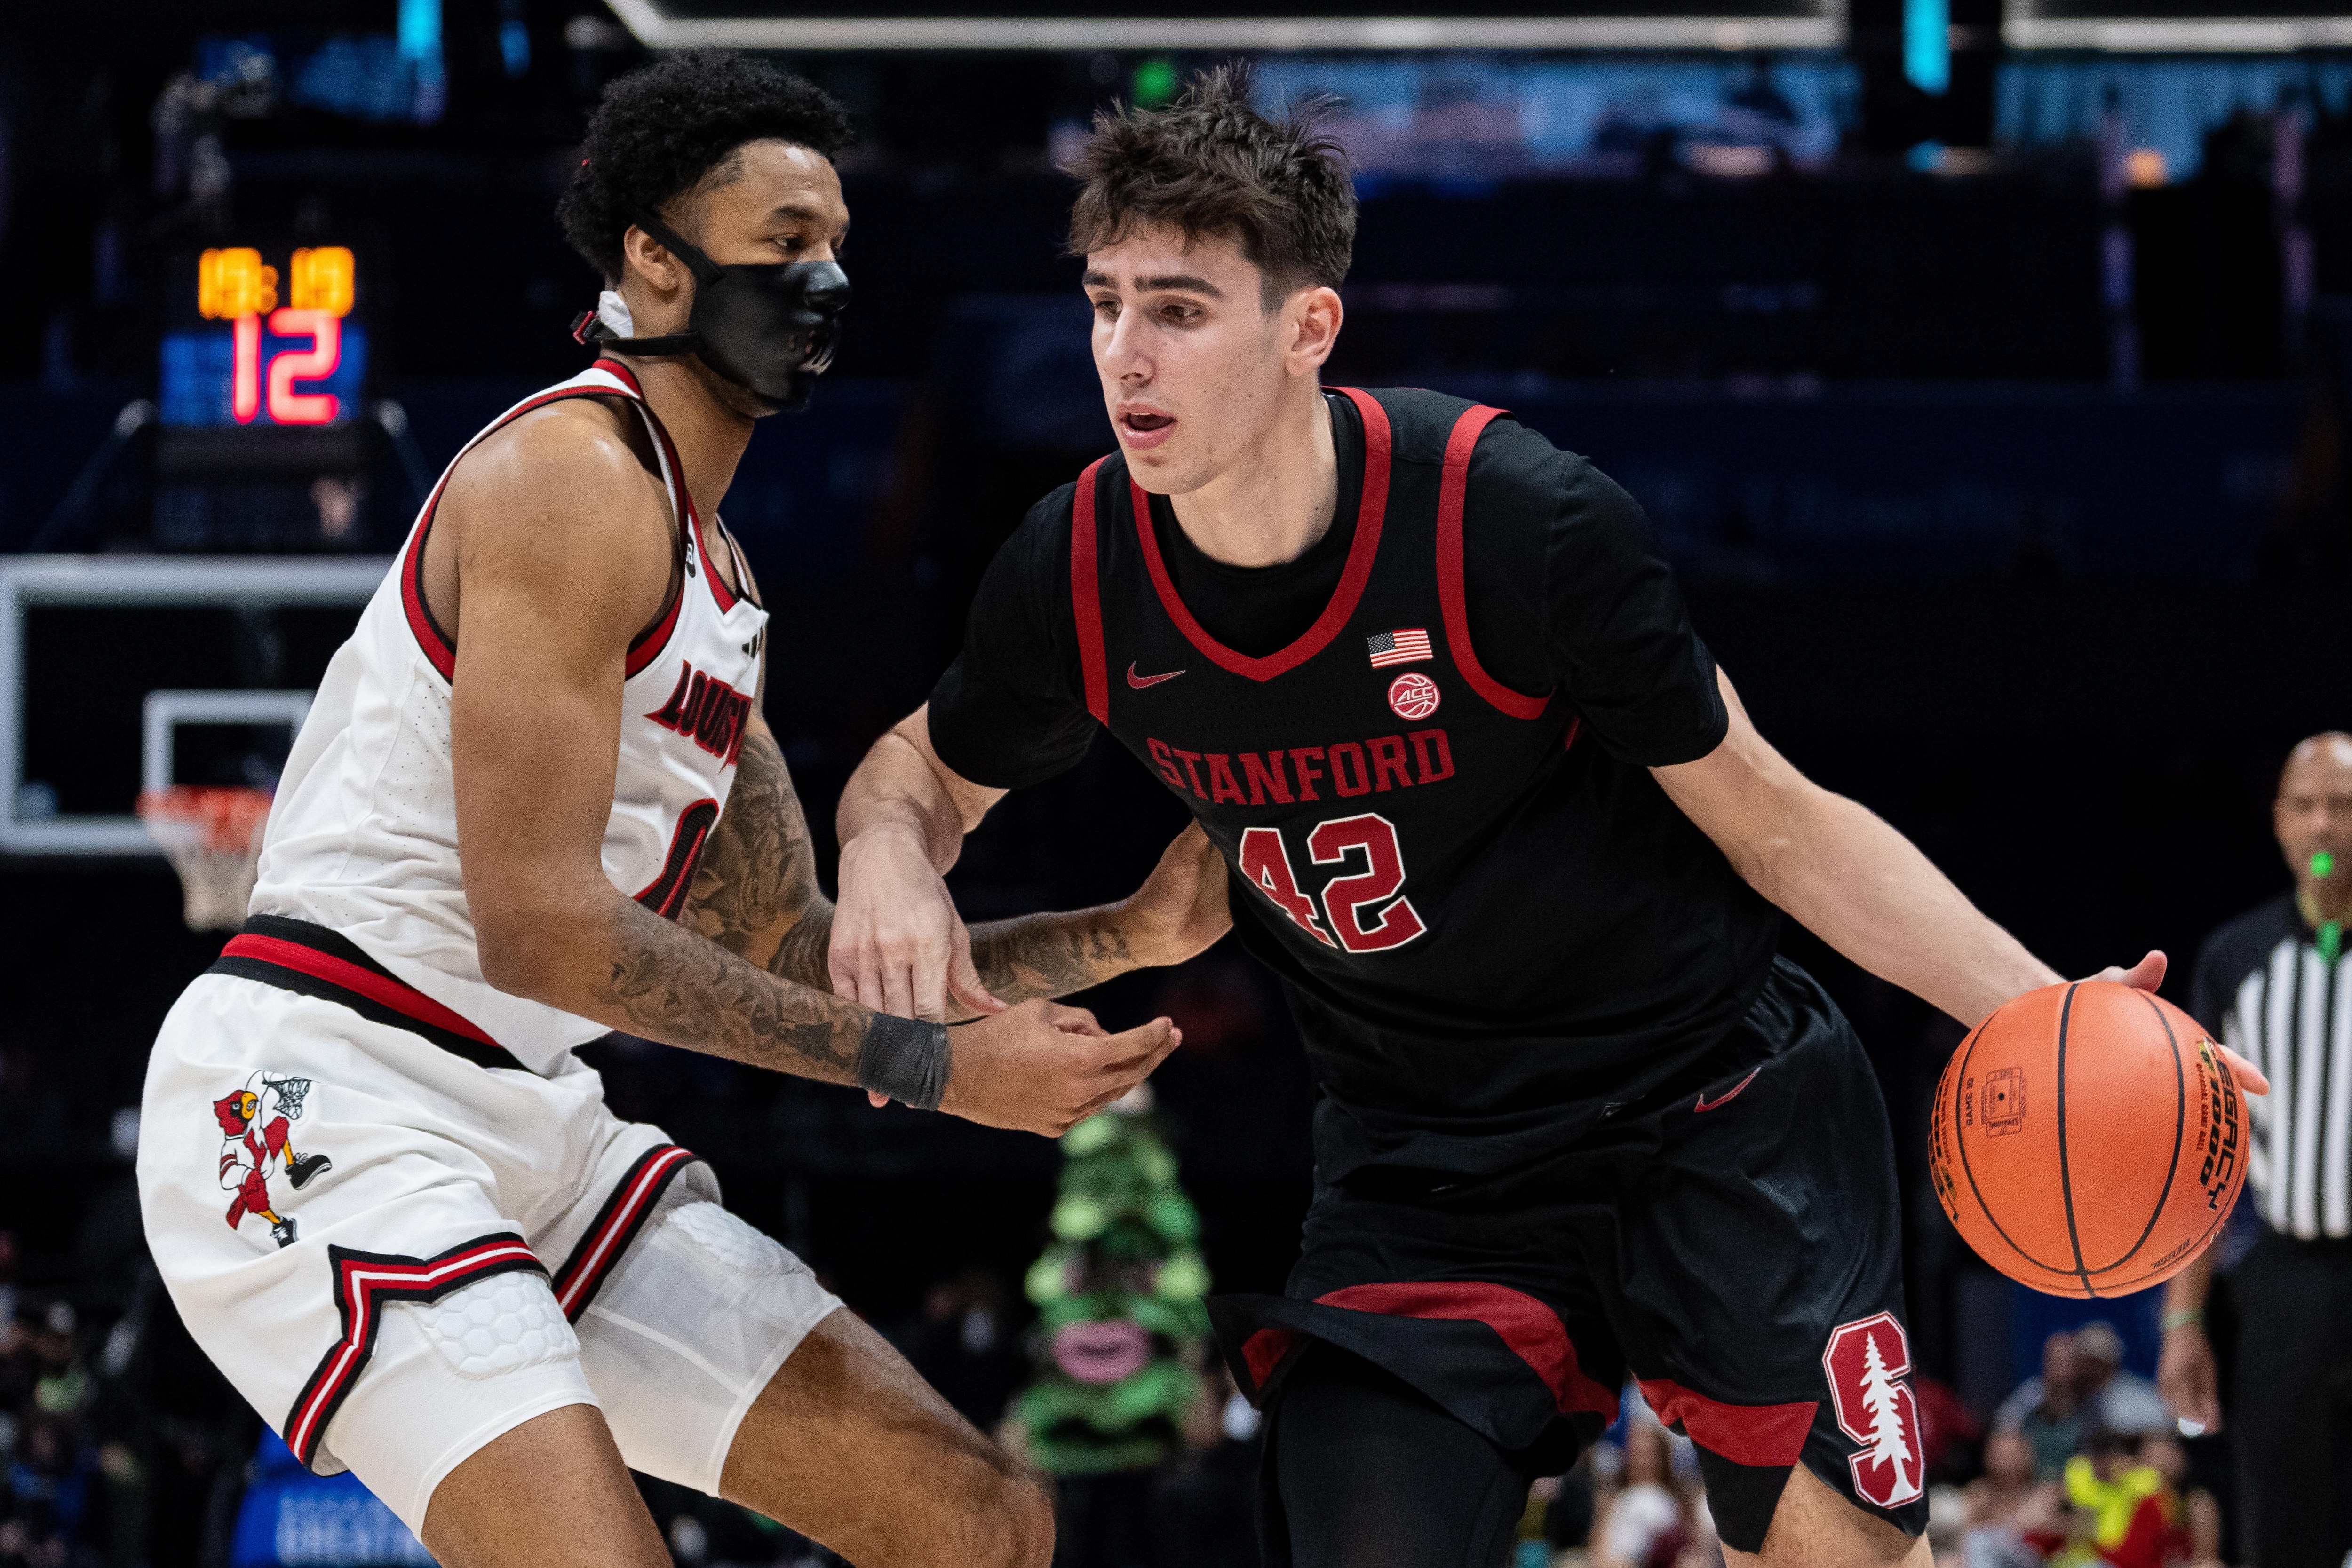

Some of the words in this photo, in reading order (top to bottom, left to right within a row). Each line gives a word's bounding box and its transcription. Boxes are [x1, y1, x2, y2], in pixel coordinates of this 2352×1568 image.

[233, 307, 342, 425] 12
[1397, 685, 1433, 703] ACC
[1146, 728, 1455, 805] STANFORD
[1239, 813, 1427, 953] 42
